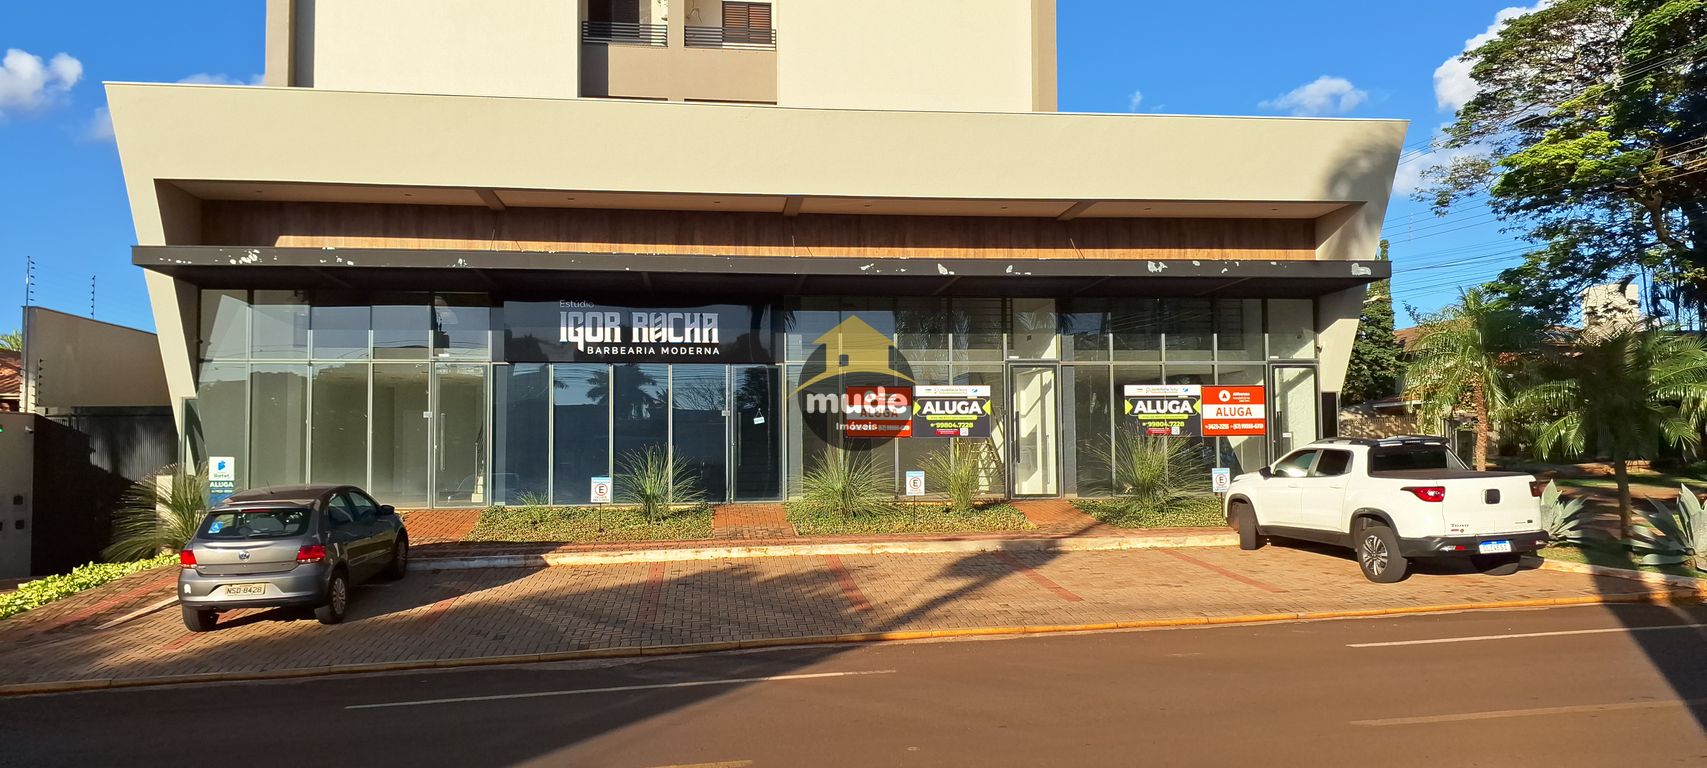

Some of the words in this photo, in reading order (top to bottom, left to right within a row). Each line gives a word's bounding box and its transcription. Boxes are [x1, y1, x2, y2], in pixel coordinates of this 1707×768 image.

[559, 300, 595, 308] Estúdio
[559, 311, 622, 352] IGOR
[631, 312, 720, 344] ROCHA
[587, 346, 656, 355] BARBEARIA
[661, 347, 720, 355] MODERNA
[860, 407, 899, 418] ALUGA
[922, 401, 983, 415] ALUGA
[1133, 400, 1194, 414] ALUGA
[1215, 407, 1253, 417] ALUGA
